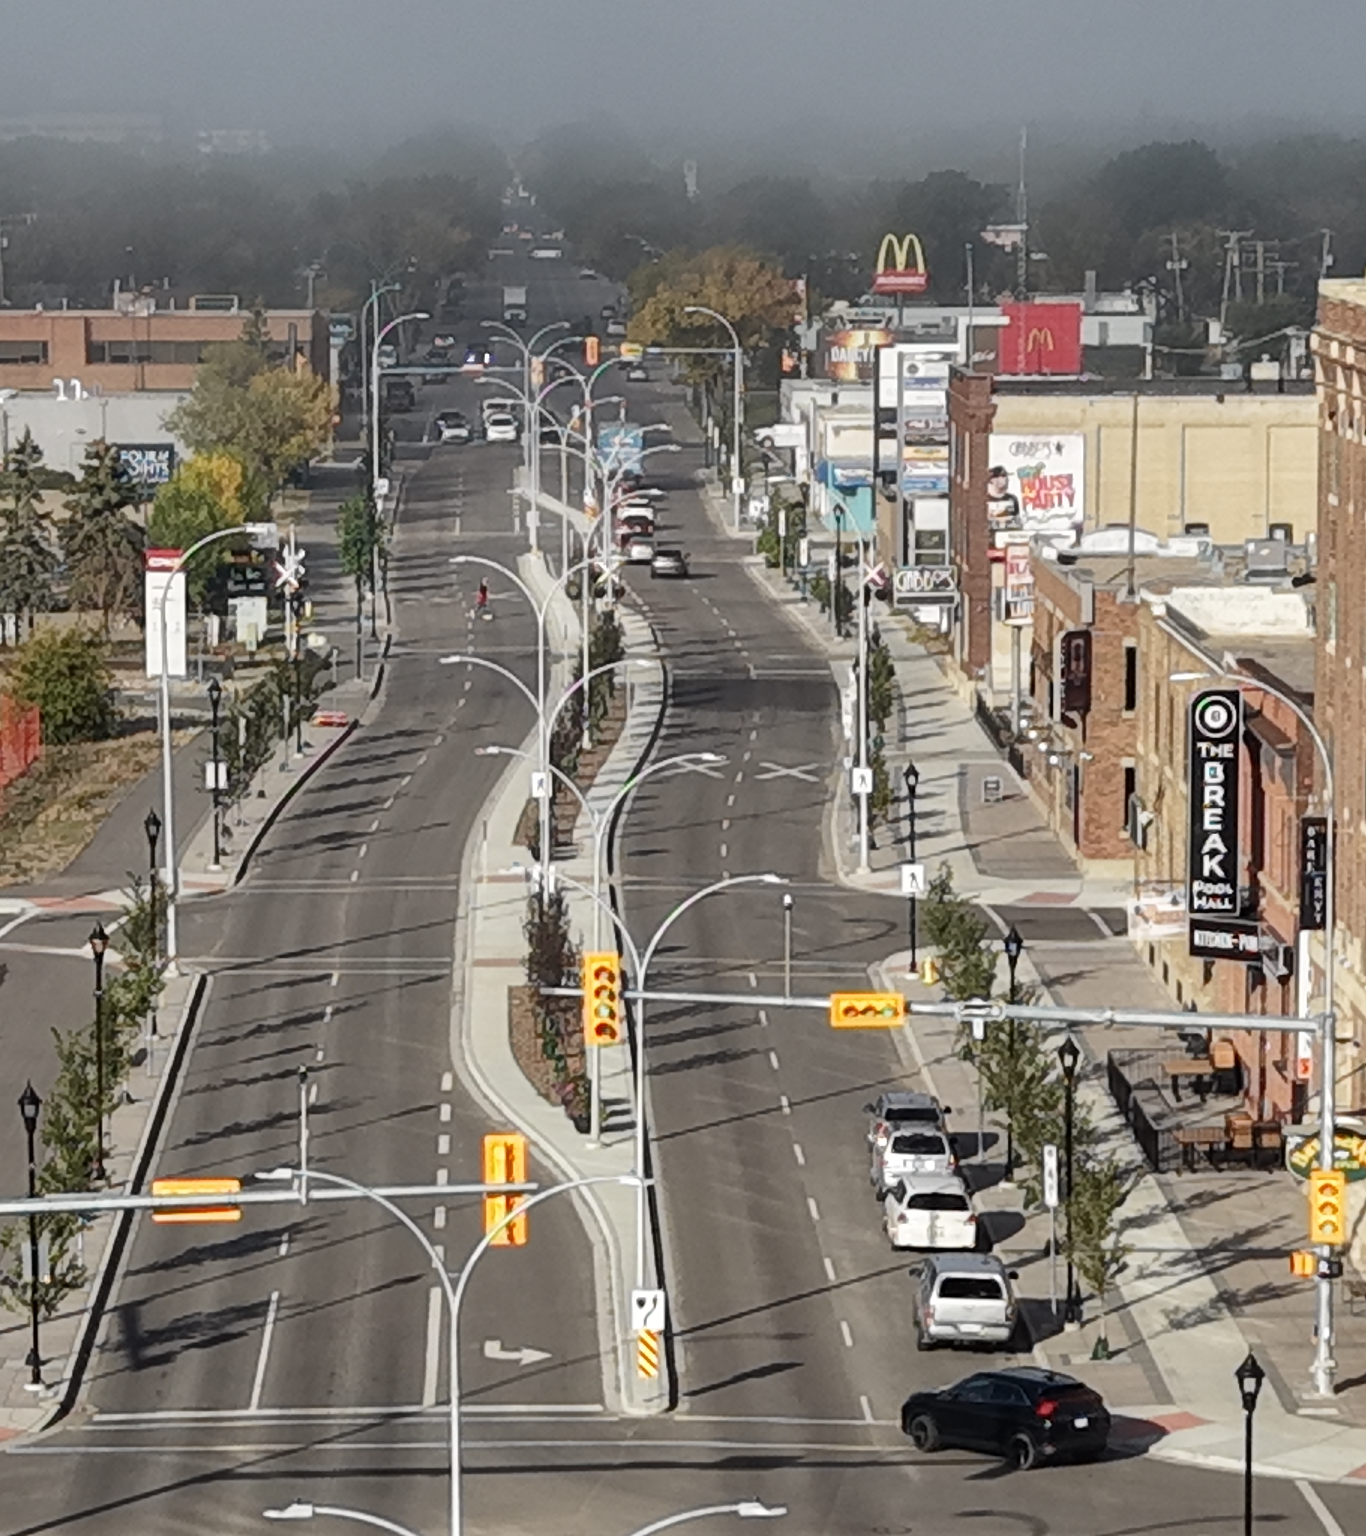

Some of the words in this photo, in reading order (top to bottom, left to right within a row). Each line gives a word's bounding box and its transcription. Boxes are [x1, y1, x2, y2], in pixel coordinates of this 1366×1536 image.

[1197, 742, 1234, 758] THE
[1201, 761, 1228, 878] BREAK
[1193, 880, 1233, 896] POOL
[1193, 894, 1233, 910] HALL
